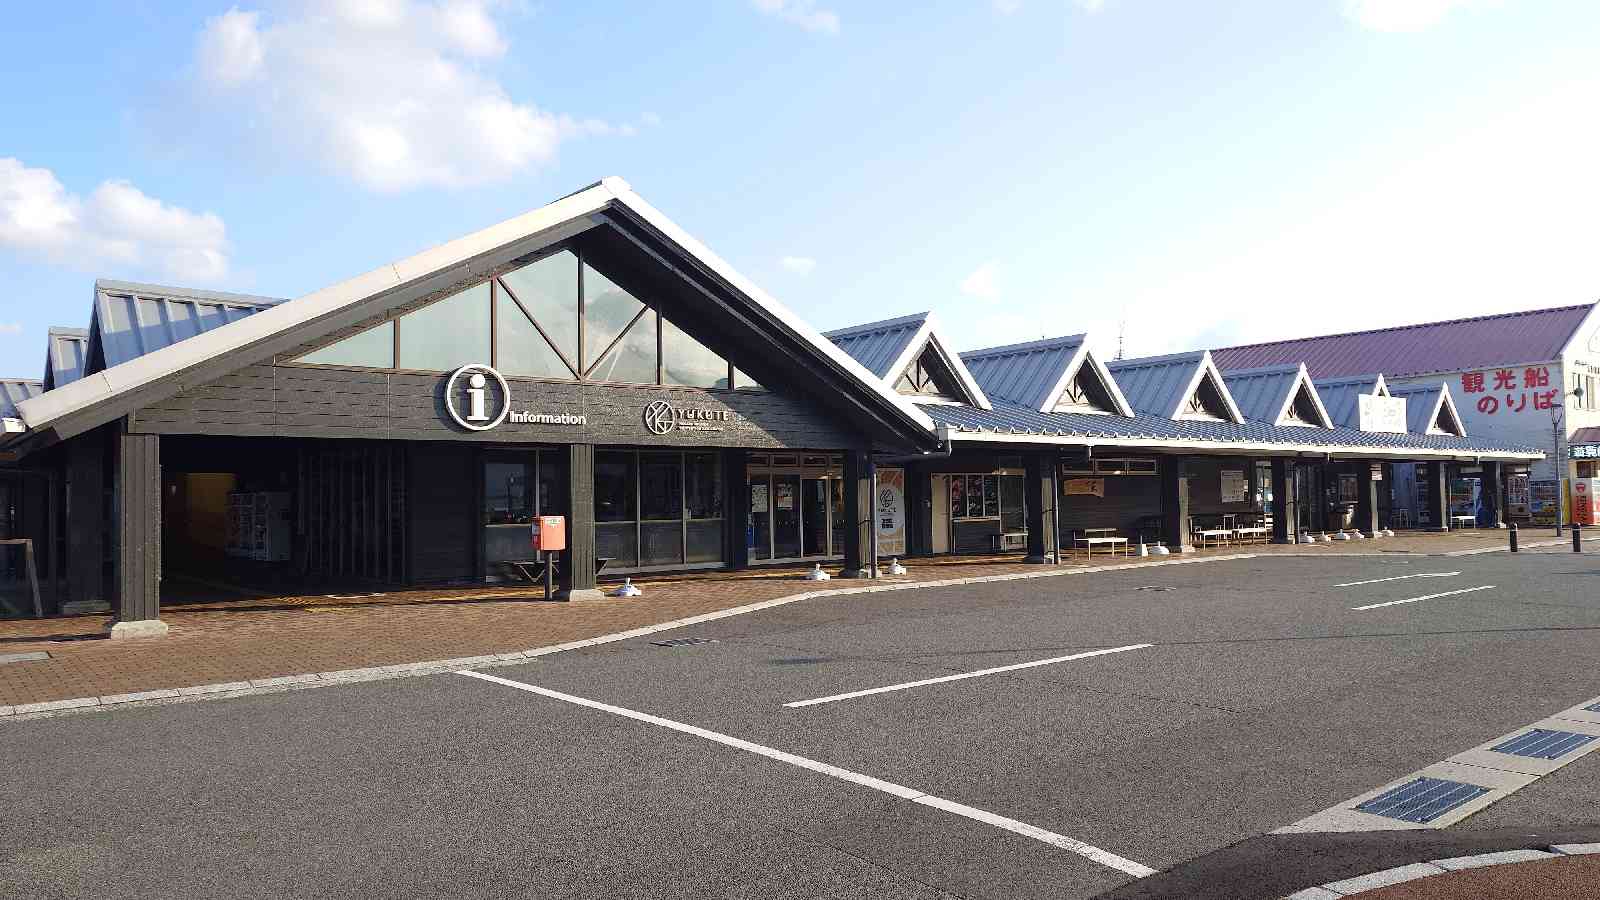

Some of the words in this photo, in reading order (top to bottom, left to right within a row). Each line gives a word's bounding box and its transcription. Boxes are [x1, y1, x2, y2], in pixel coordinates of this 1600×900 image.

[1461, 366, 1550, 393] 観光船
[1476, 388, 1559, 415] のりば
[509, 410, 587, 425] Information
[678, 408, 730, 421] YUKUTE
[1573, 445, 1600, 458] 遊覧
